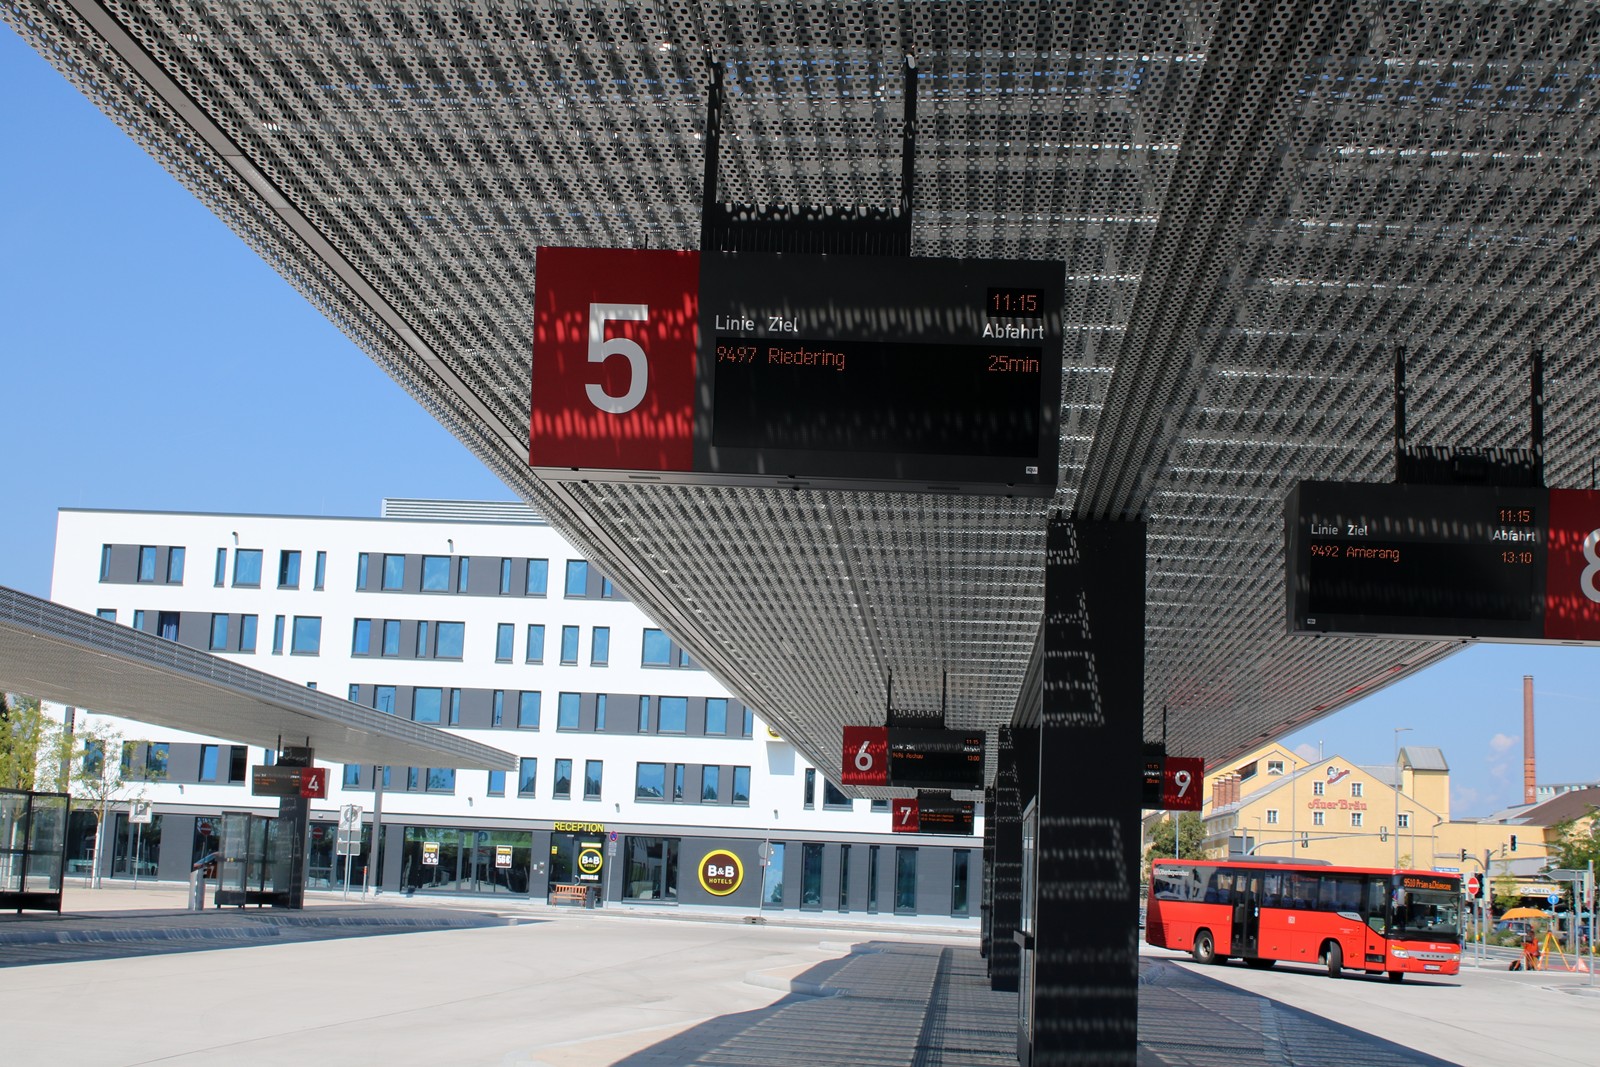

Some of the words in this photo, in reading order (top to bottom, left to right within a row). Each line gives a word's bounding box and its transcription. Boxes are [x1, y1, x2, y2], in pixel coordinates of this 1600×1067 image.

[993, 294, 1037, 311] 11:15
[715, 315, 755, 331] Linie
[768, 316, 798, 332] Ziel
[982, 323, 1044, 340] Abfahrt
[584, 303, 649, 415] 5
[717, 346, 757, 363] 9497
[768, 347, 845, 371] Riedering
[988, 355, 1039, 373] 25min
[1499, 510, 1530, 522] 11:15
[1311, 524, 1339, 535] Linie
[1347, 524, 1368, 536] Ziel
[1493, 530, 1535, 542] Abfahrt
[1311, 545, 1339, 558] 9492
[1346, 546, 1400, 563] Amerang
[1501, 551, 1532, 564] 13:10
[855, 741, 873, 771] 6
[308, 774, 320, 792] 4
[1175, 770, 1192, 798] 9
[1308, 798, 1338, 809] Auer
[1338, 799, 1368, 811] Bräu
[900, 806, 912, 825] 7
[553, 821, 605, 833] RECEPTION
[581, 855, 600, 865] B&B
[707, 864, 735, 878] B&B
